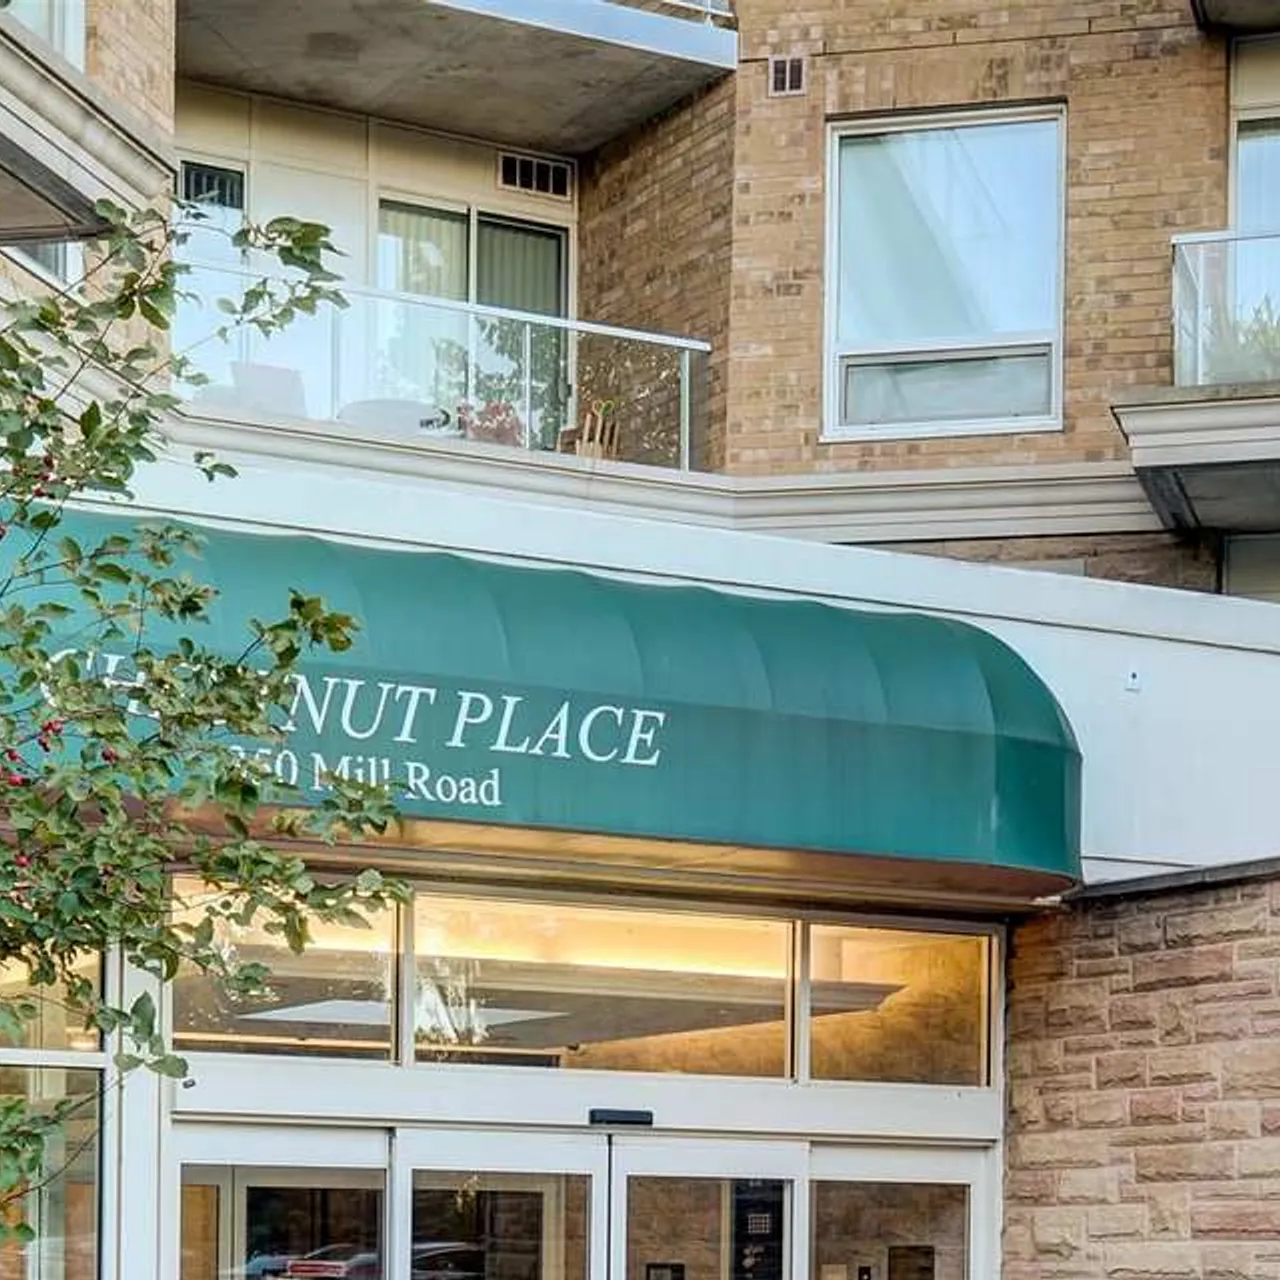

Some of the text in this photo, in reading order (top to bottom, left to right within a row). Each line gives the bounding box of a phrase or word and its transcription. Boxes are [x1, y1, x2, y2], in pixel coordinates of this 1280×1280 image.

[445, 690, 665, 766] PLACE
[311, 751, 391, 796] Mill
[404, 761, 502, 806] Road
